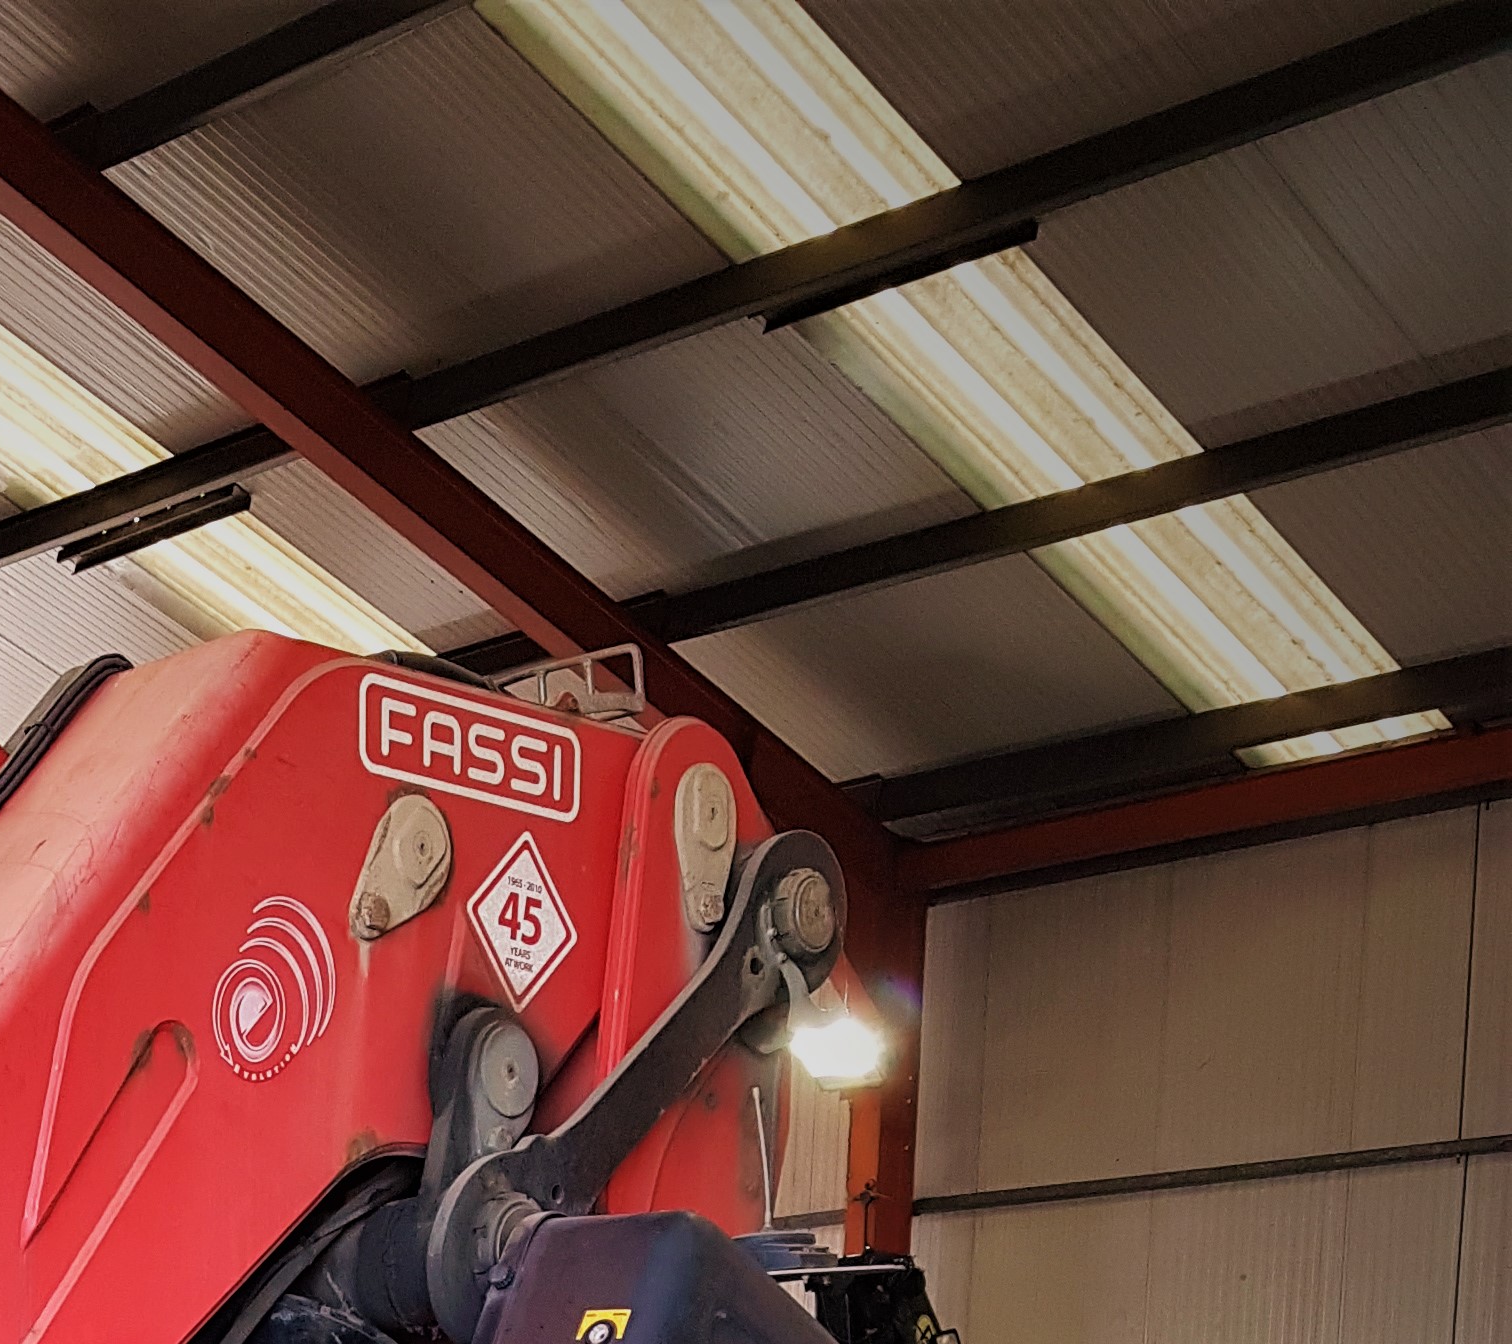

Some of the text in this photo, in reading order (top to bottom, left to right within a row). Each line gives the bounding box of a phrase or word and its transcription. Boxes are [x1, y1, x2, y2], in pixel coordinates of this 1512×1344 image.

[380, 696, 562, 801] FASSI
[498, 892, 542, 946] 45
[510, 947, 531, 960] YEARS
